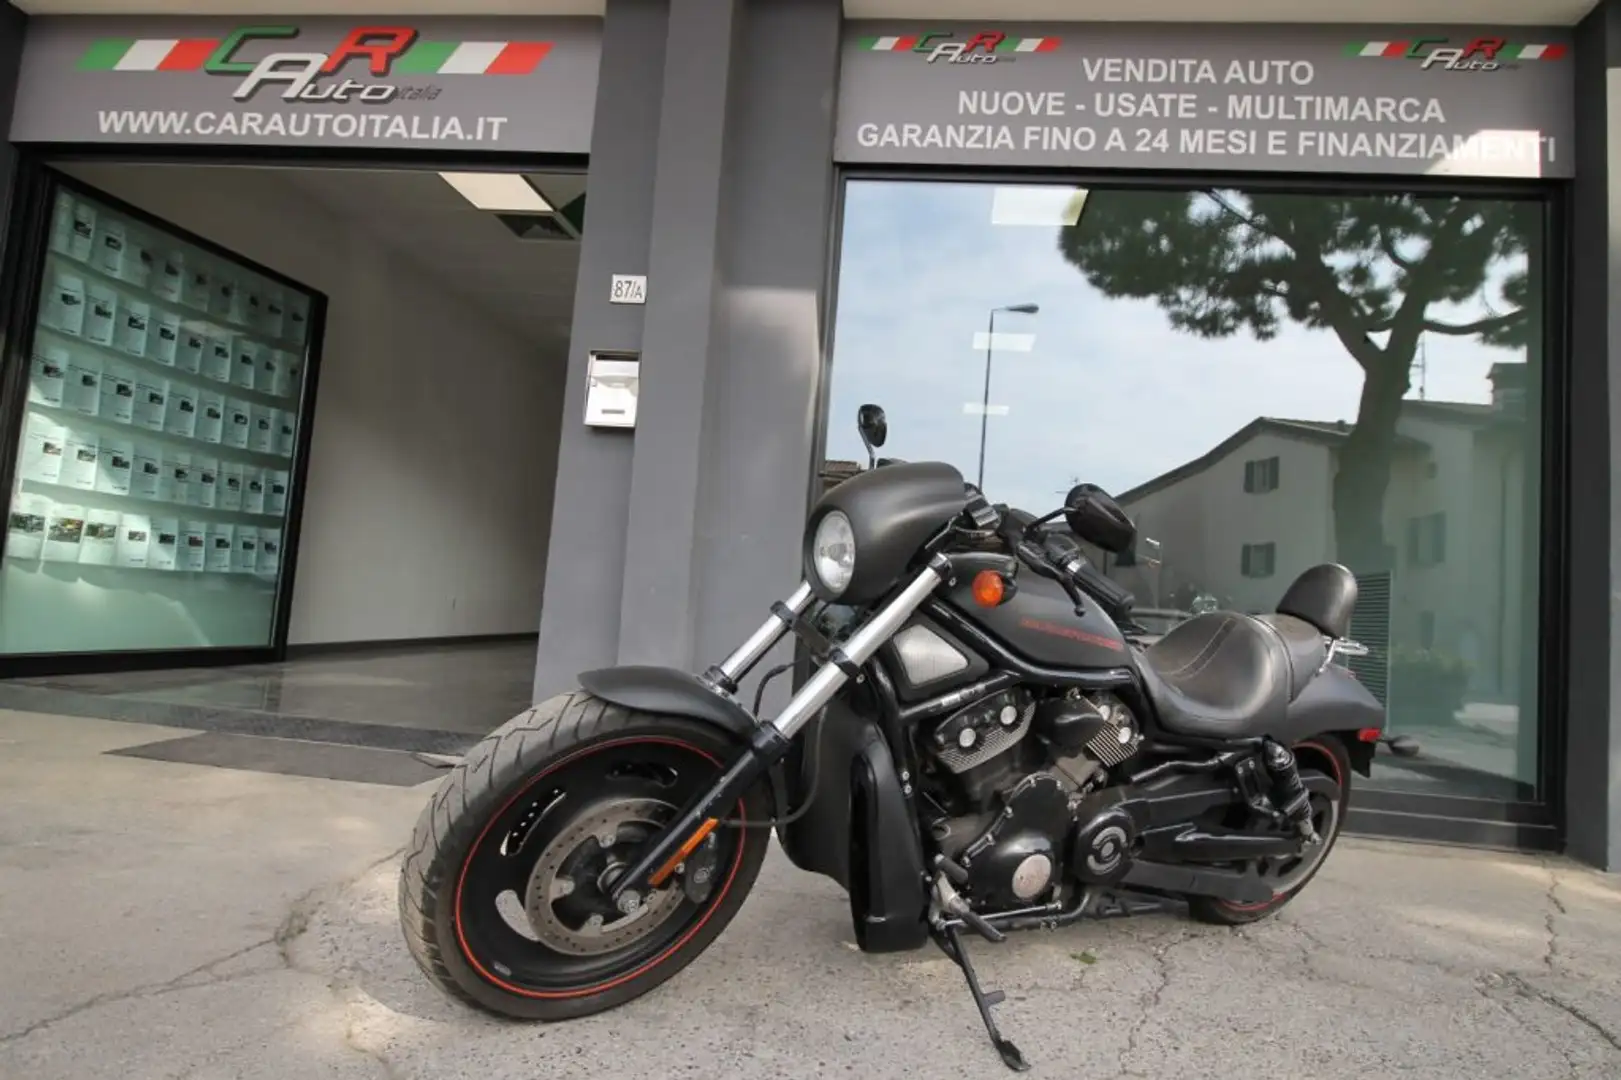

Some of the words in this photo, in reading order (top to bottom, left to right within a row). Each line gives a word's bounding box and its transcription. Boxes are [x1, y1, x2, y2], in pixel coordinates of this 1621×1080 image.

[1082, 58, 1217, 84] VENDITA
[1223, 60, 1315, 86] AUTO
[958, 90, 1065, 117] NUOVE
[1094, 93, 1197, 119] USATE
[1227, 95, 1447, 124] MULTIMARCA
[98, 110, 508, 142] WWW.CARAUTOITALIA.IT
[857, 123, 1016, 149] GARANZIA
[1024, 126, 1097, 151] FINO
[1104, 128, 1127, 152] A
[1135, 128, 1169, 153] 24
[1179, 129, 1257, 155] MESI
[1267, 131, 1288, 155] E
[613, 279, 643, 299] 87/A
